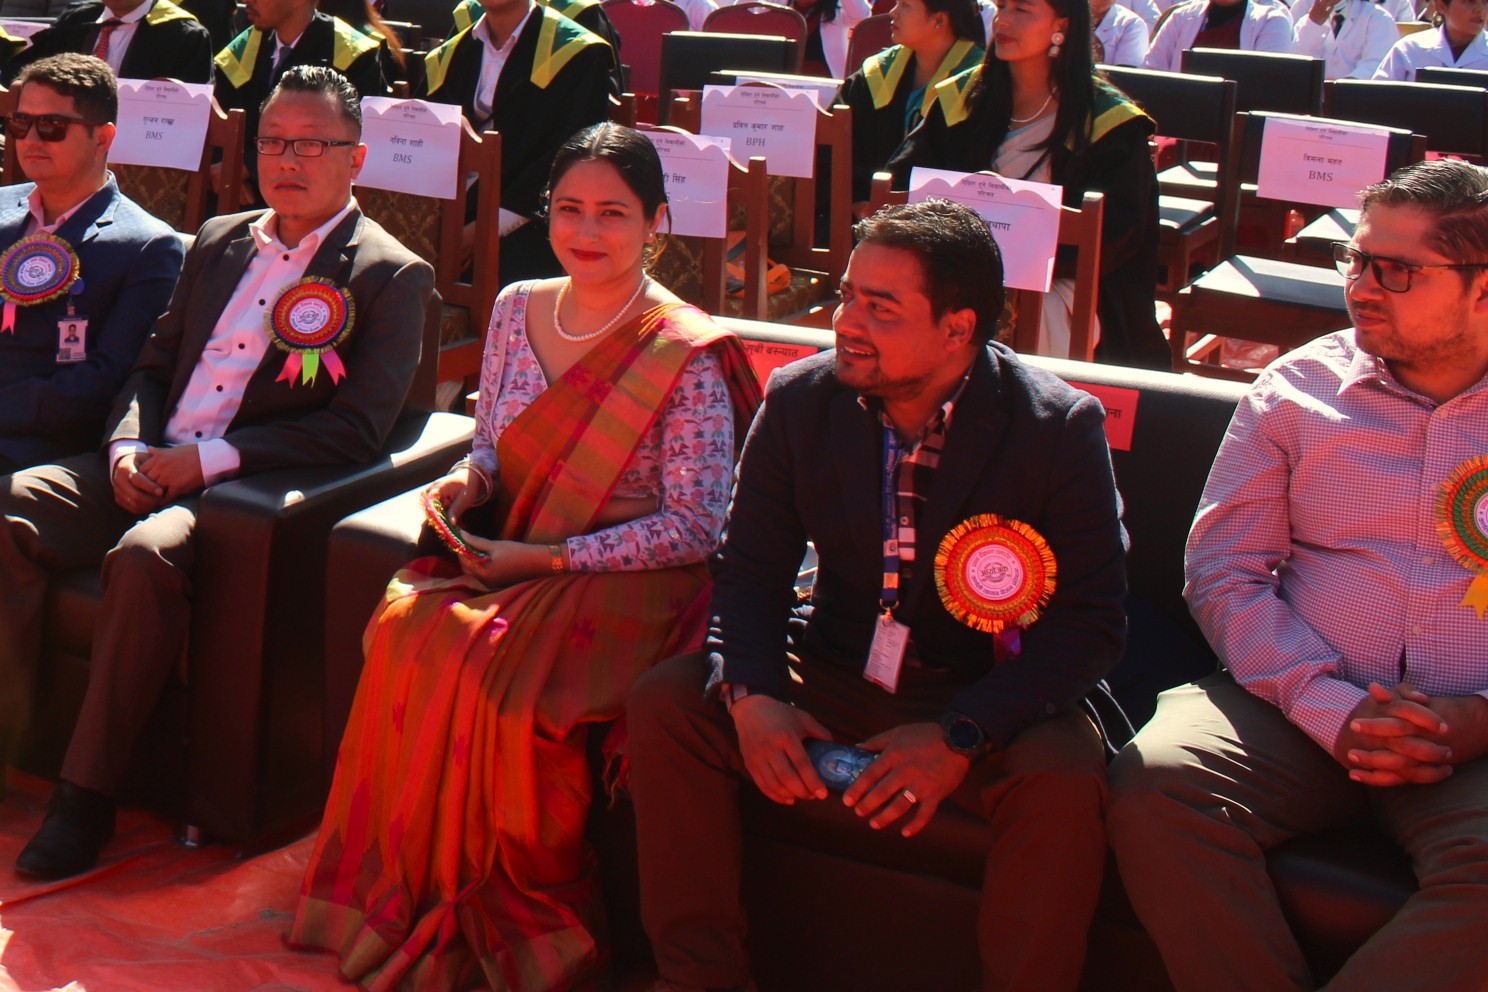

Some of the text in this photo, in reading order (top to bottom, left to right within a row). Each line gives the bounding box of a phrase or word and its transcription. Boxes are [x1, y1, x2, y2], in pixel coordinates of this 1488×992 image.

[145, 130, 164, 139] BMS
[746, 137, 766, 146] BPH
[393, 153, 413, 163] BMS
[1308, 170, 1333, 181] BMS
